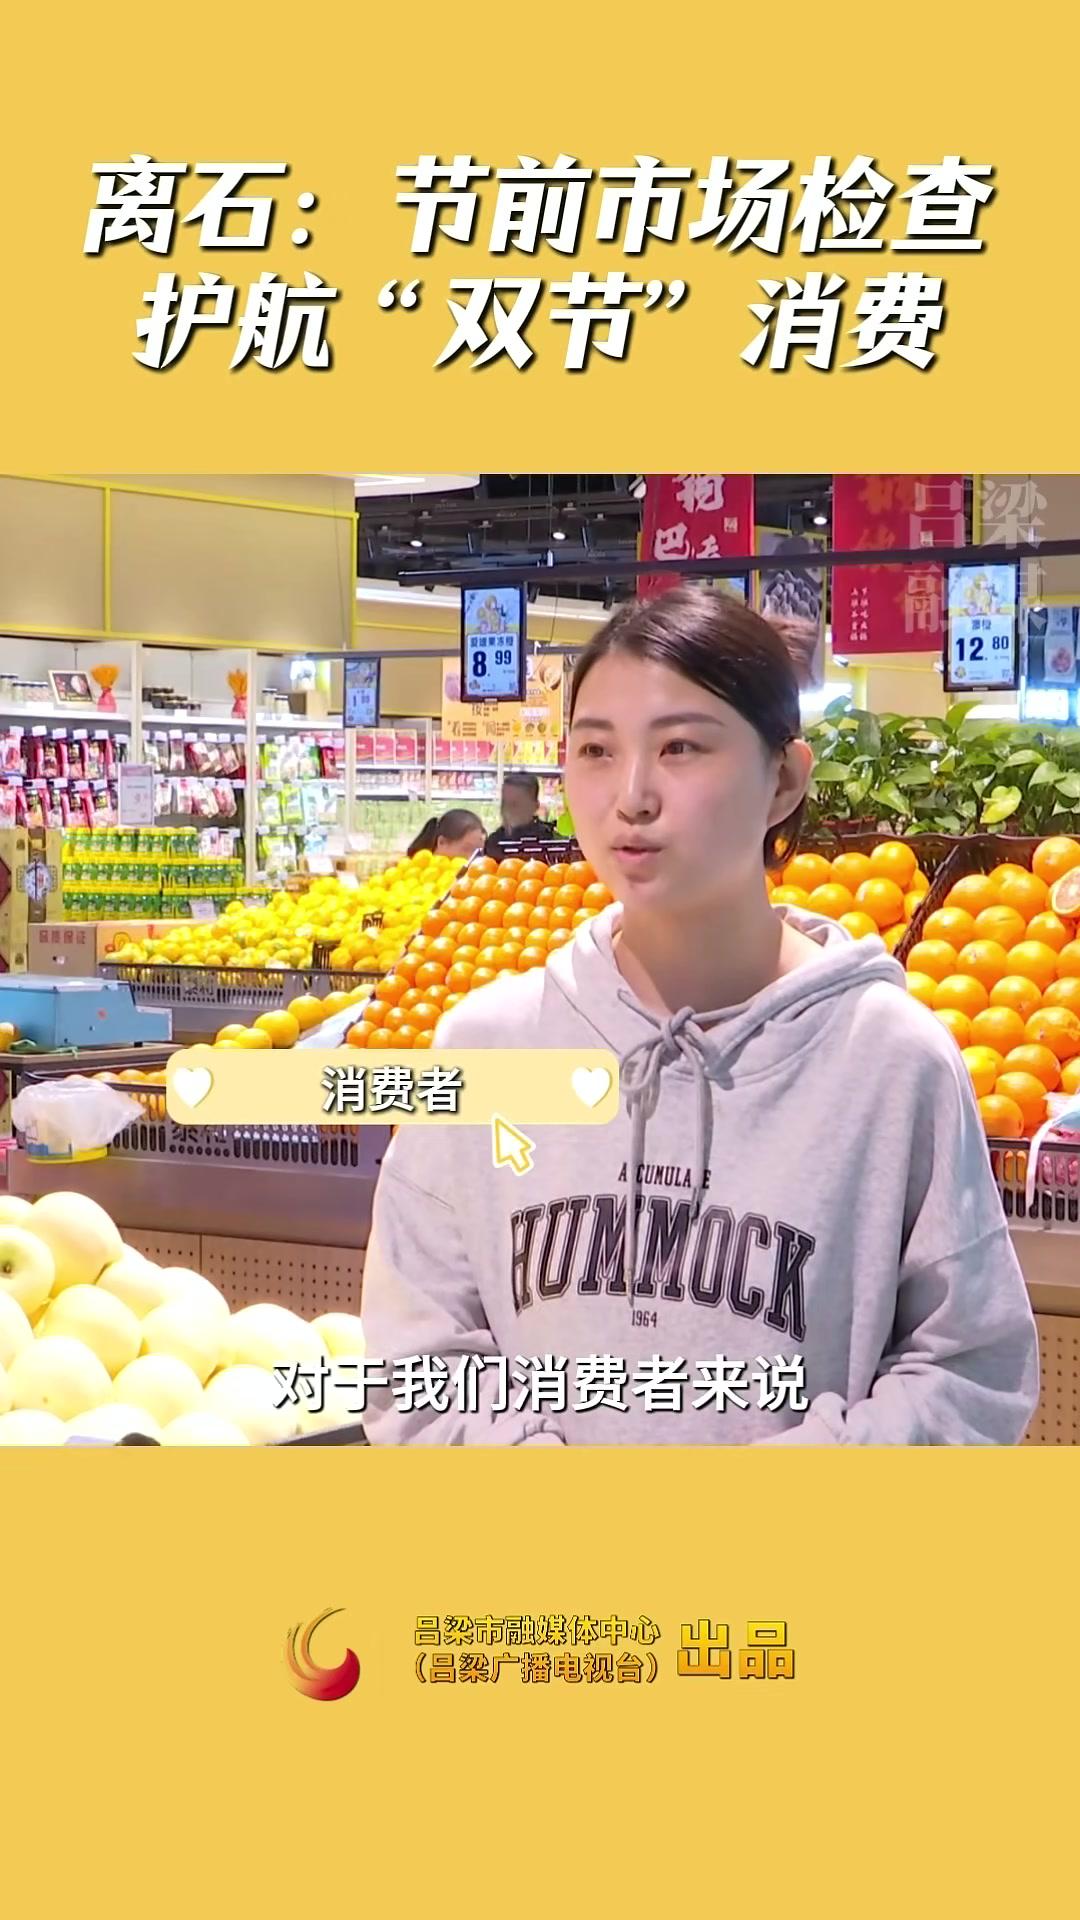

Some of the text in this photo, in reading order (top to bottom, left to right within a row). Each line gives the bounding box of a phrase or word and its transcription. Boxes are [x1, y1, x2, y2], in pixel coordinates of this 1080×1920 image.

[617, 1161, 712, 1190] ACUMULAE
[510, 1193, 816, 1343] HUMMOCK
[631, 1309, 658, 1329] 1964
